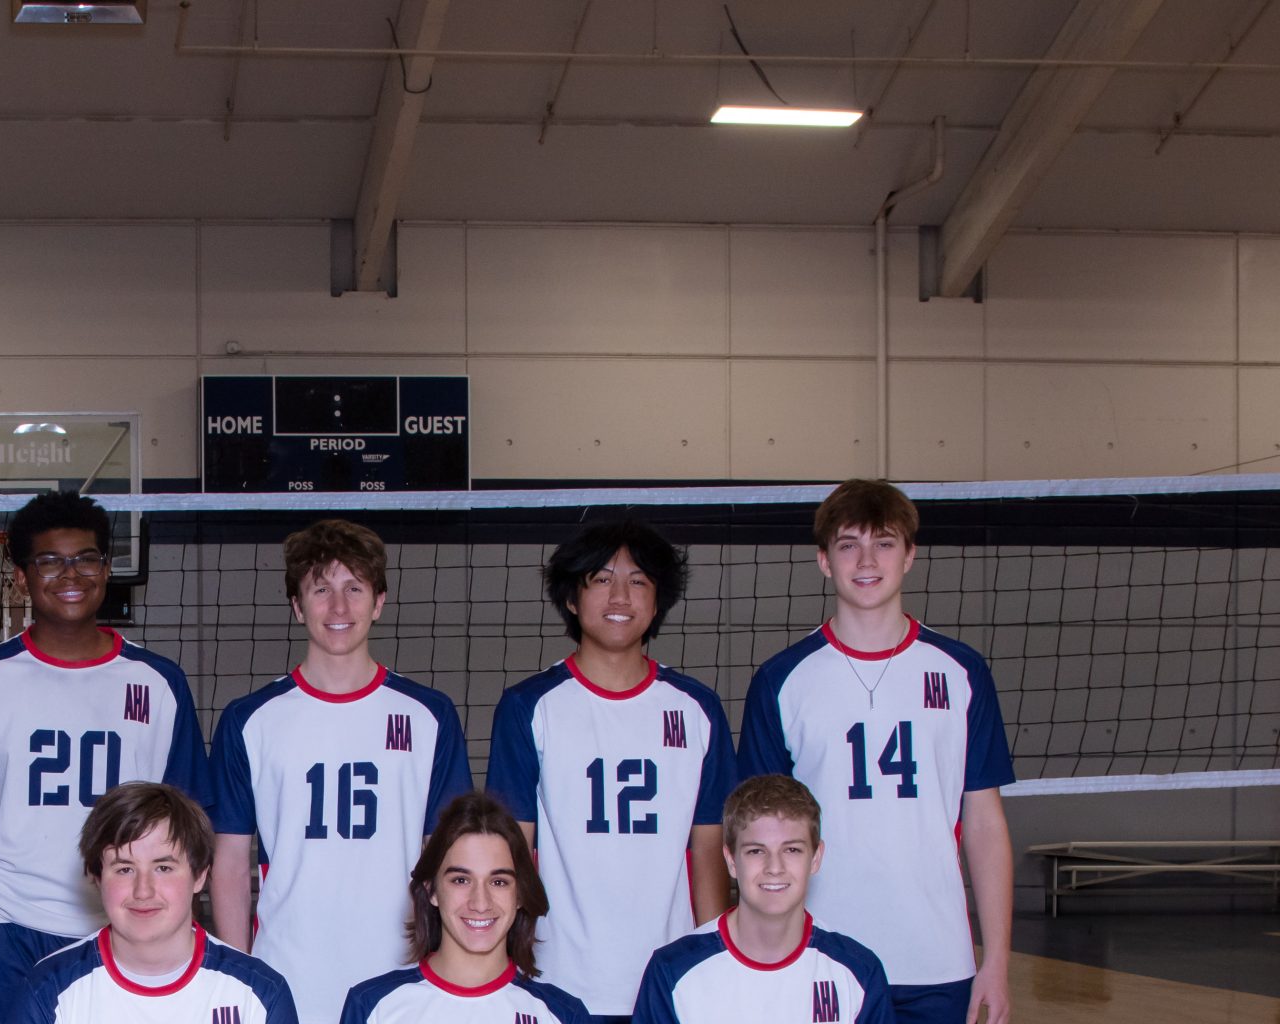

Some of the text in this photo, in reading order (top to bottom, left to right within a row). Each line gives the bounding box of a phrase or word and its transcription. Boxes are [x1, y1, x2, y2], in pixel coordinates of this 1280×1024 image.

[207, 416, 263, 434] HOME
[310, 438, 366, 450] PERIOD
[404, 416, 466, 434] GUEST
[288, 481, 314, 490] POSS
[360, 481, 386, 490] POSS
[124, 684, 149, 724] AHA
[924, 672, 950, 710] AHA
[386, 714, 412, 752] AHA
[664, 711, 687, 748] AHA
[29, 729, 122, 807] 20
[847, 721, 917, 799] 14
[305, 762, 378, 839] 16
[587, 758, 657, 834] 12
[813, 981, 839, 1023] AHA
